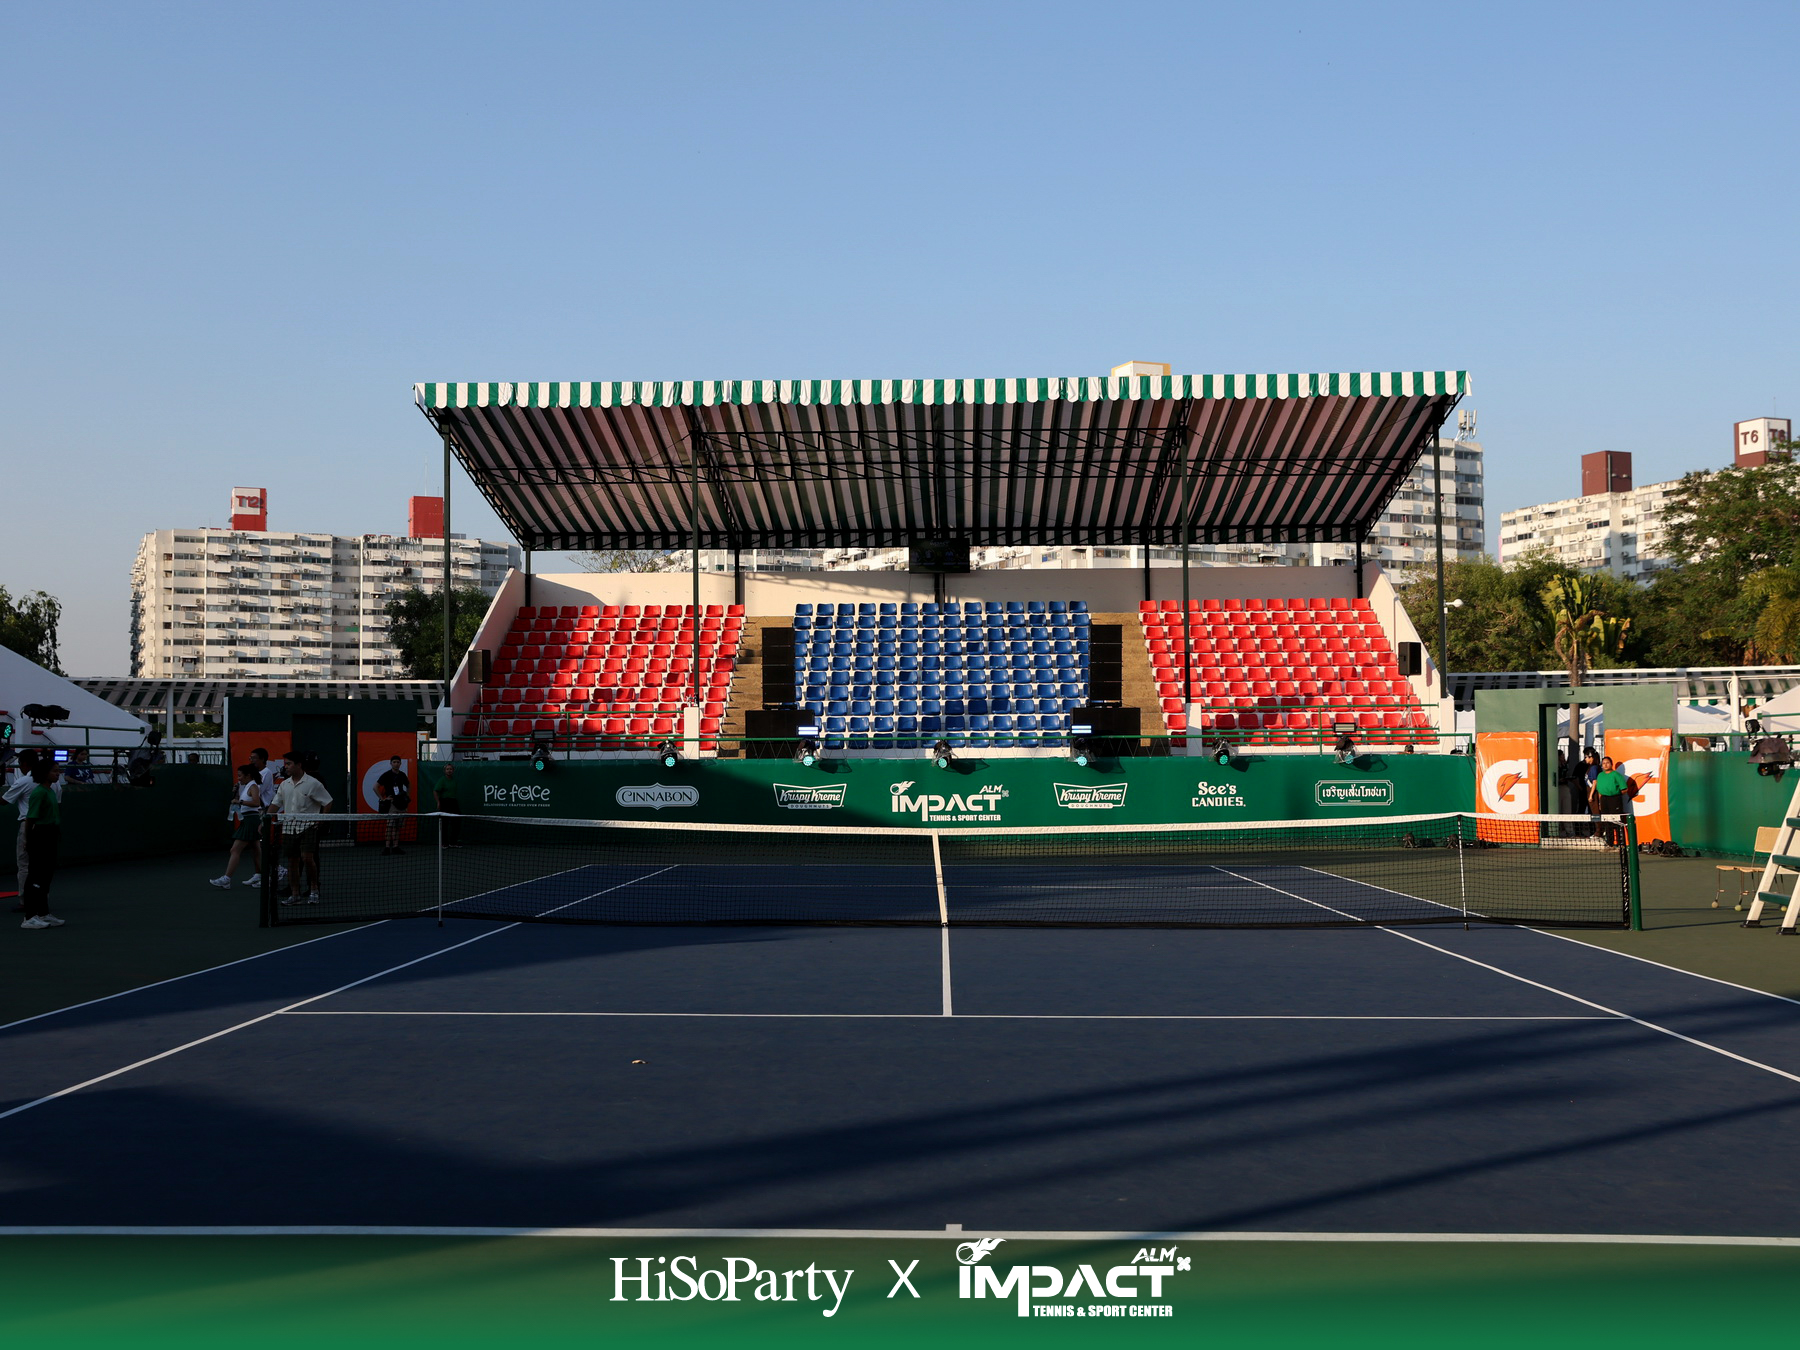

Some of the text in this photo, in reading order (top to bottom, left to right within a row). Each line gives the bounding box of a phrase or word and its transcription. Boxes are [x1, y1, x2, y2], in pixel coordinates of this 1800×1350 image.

[1740, 429, 1759, 445] T6
[235, 495, 260, 509] T12
[483, 783, 551, 802] Pie face
[979, 784, 1003, 794] ALM
[1197, 781, 1237, 796] See's
[1322, 783, 1387, 800] เจริญเส้นโภชนา
[1481, 758, 1530, 814] G
[621, 790, 693, 803] CINNABON
[779, 789, 842, 804] Krispy Kreme
[1060, 788, 1123, 803] Krispy Kreme
[1191, 796, 1244, 807] CANDIES
[891, 793, 1002, 822] IMPACT
[929, 814, 951, 822] TENNIS
[957, 814, 977, 822] SPORT
[978, 814, 1002, 822] CENTER
